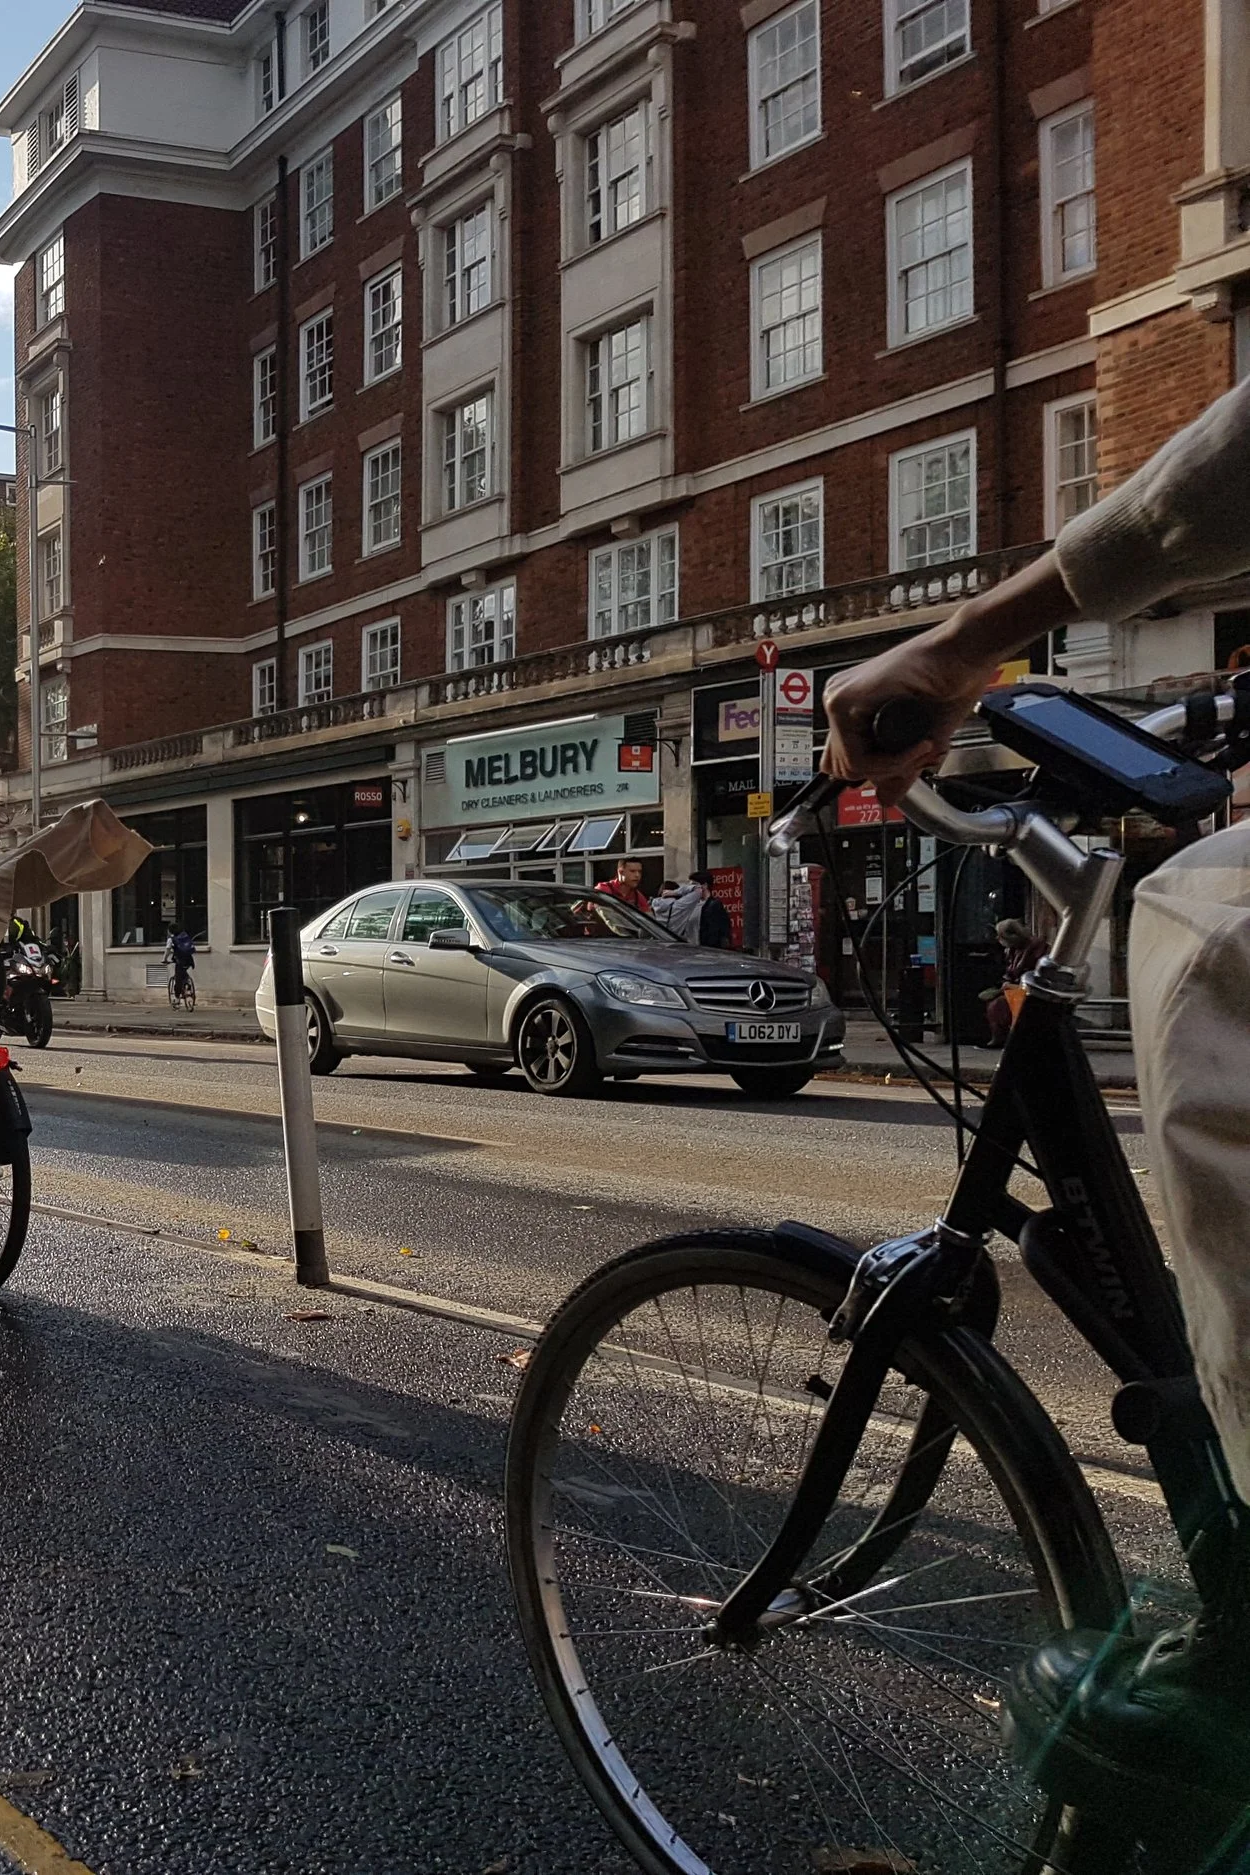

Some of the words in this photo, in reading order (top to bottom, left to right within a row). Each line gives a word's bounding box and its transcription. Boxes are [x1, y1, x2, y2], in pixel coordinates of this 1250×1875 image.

[762, 644, 775, 664] Y
[464, 738, 599, 789] MELBURY
[728, 779, 756, 793] MAIL
[354, 791, 383, 801] ROSSO
[461, 799, 479, 812] DRY
[481, 792, 529, 809] CLEANERS
[530, 792, 537, 804] &
[538, 783, 604, 802] LAUNDERERS
[859, 809, 880, 823] 272
[734, 886, 742, 897] &
[738, 1024, 775, 1040] LO62
[777, 1024, 799, 1040] DYJ
